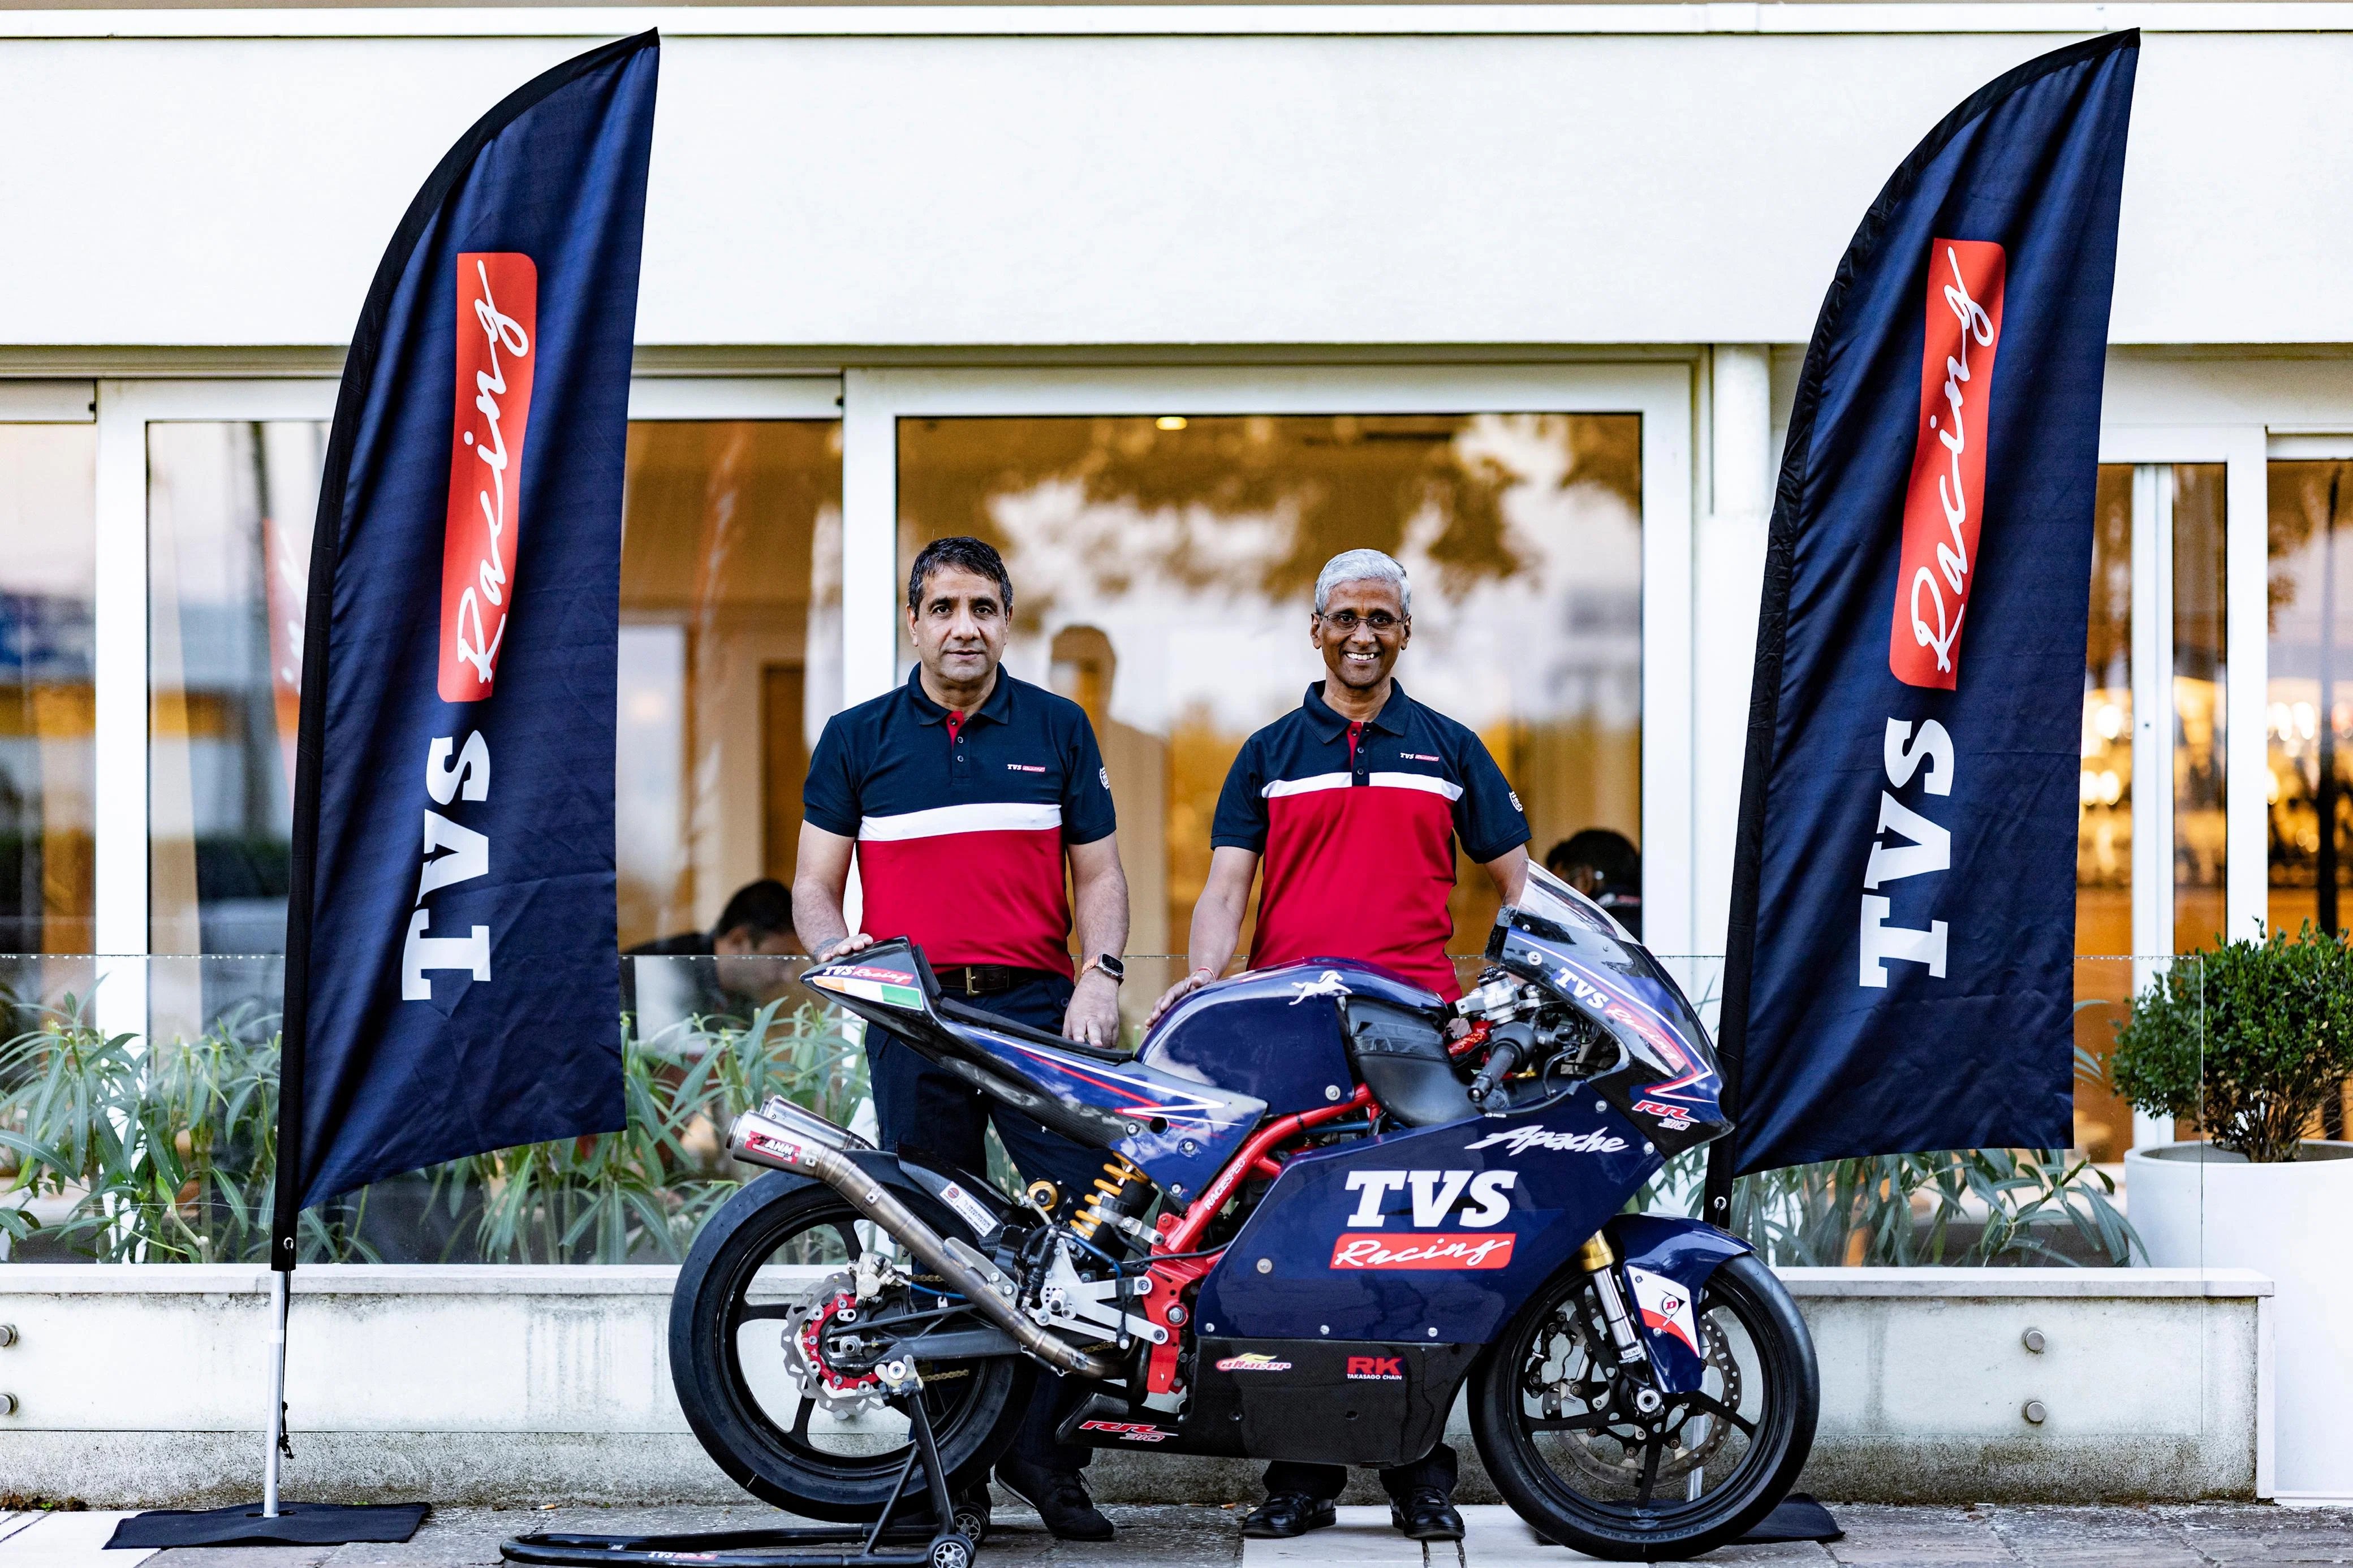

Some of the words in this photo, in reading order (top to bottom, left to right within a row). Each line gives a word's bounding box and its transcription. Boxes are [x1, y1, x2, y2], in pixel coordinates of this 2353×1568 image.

[402, 730, 491, 1000] TVS
[457, 260, 529, 684] Racing
[1859, 716, 1955, 988] TVS
[1910, 247, 1994, 673] Racing
[822, 965, 856, 976] TVS
[852, 968, 913, 983] Racing
[1555, 967, 1609, 1009] TVS
[1605, 1008, 1683, 1065] Racing
[1631, 1099, 1700, 1123] RR
[1658, 1117, 1691, 1131] 310
[1464, 1125, 1630, 1156] Apache
[1345, 1170, 1518, 1228] TVS
[1334, 1238, 1511, 1267] Racing
[1347, 1357, 1402, 1376] RK
[1079, 1420, 1179, 1436] RR
[1119, 1432, 1165, 1442] 310
